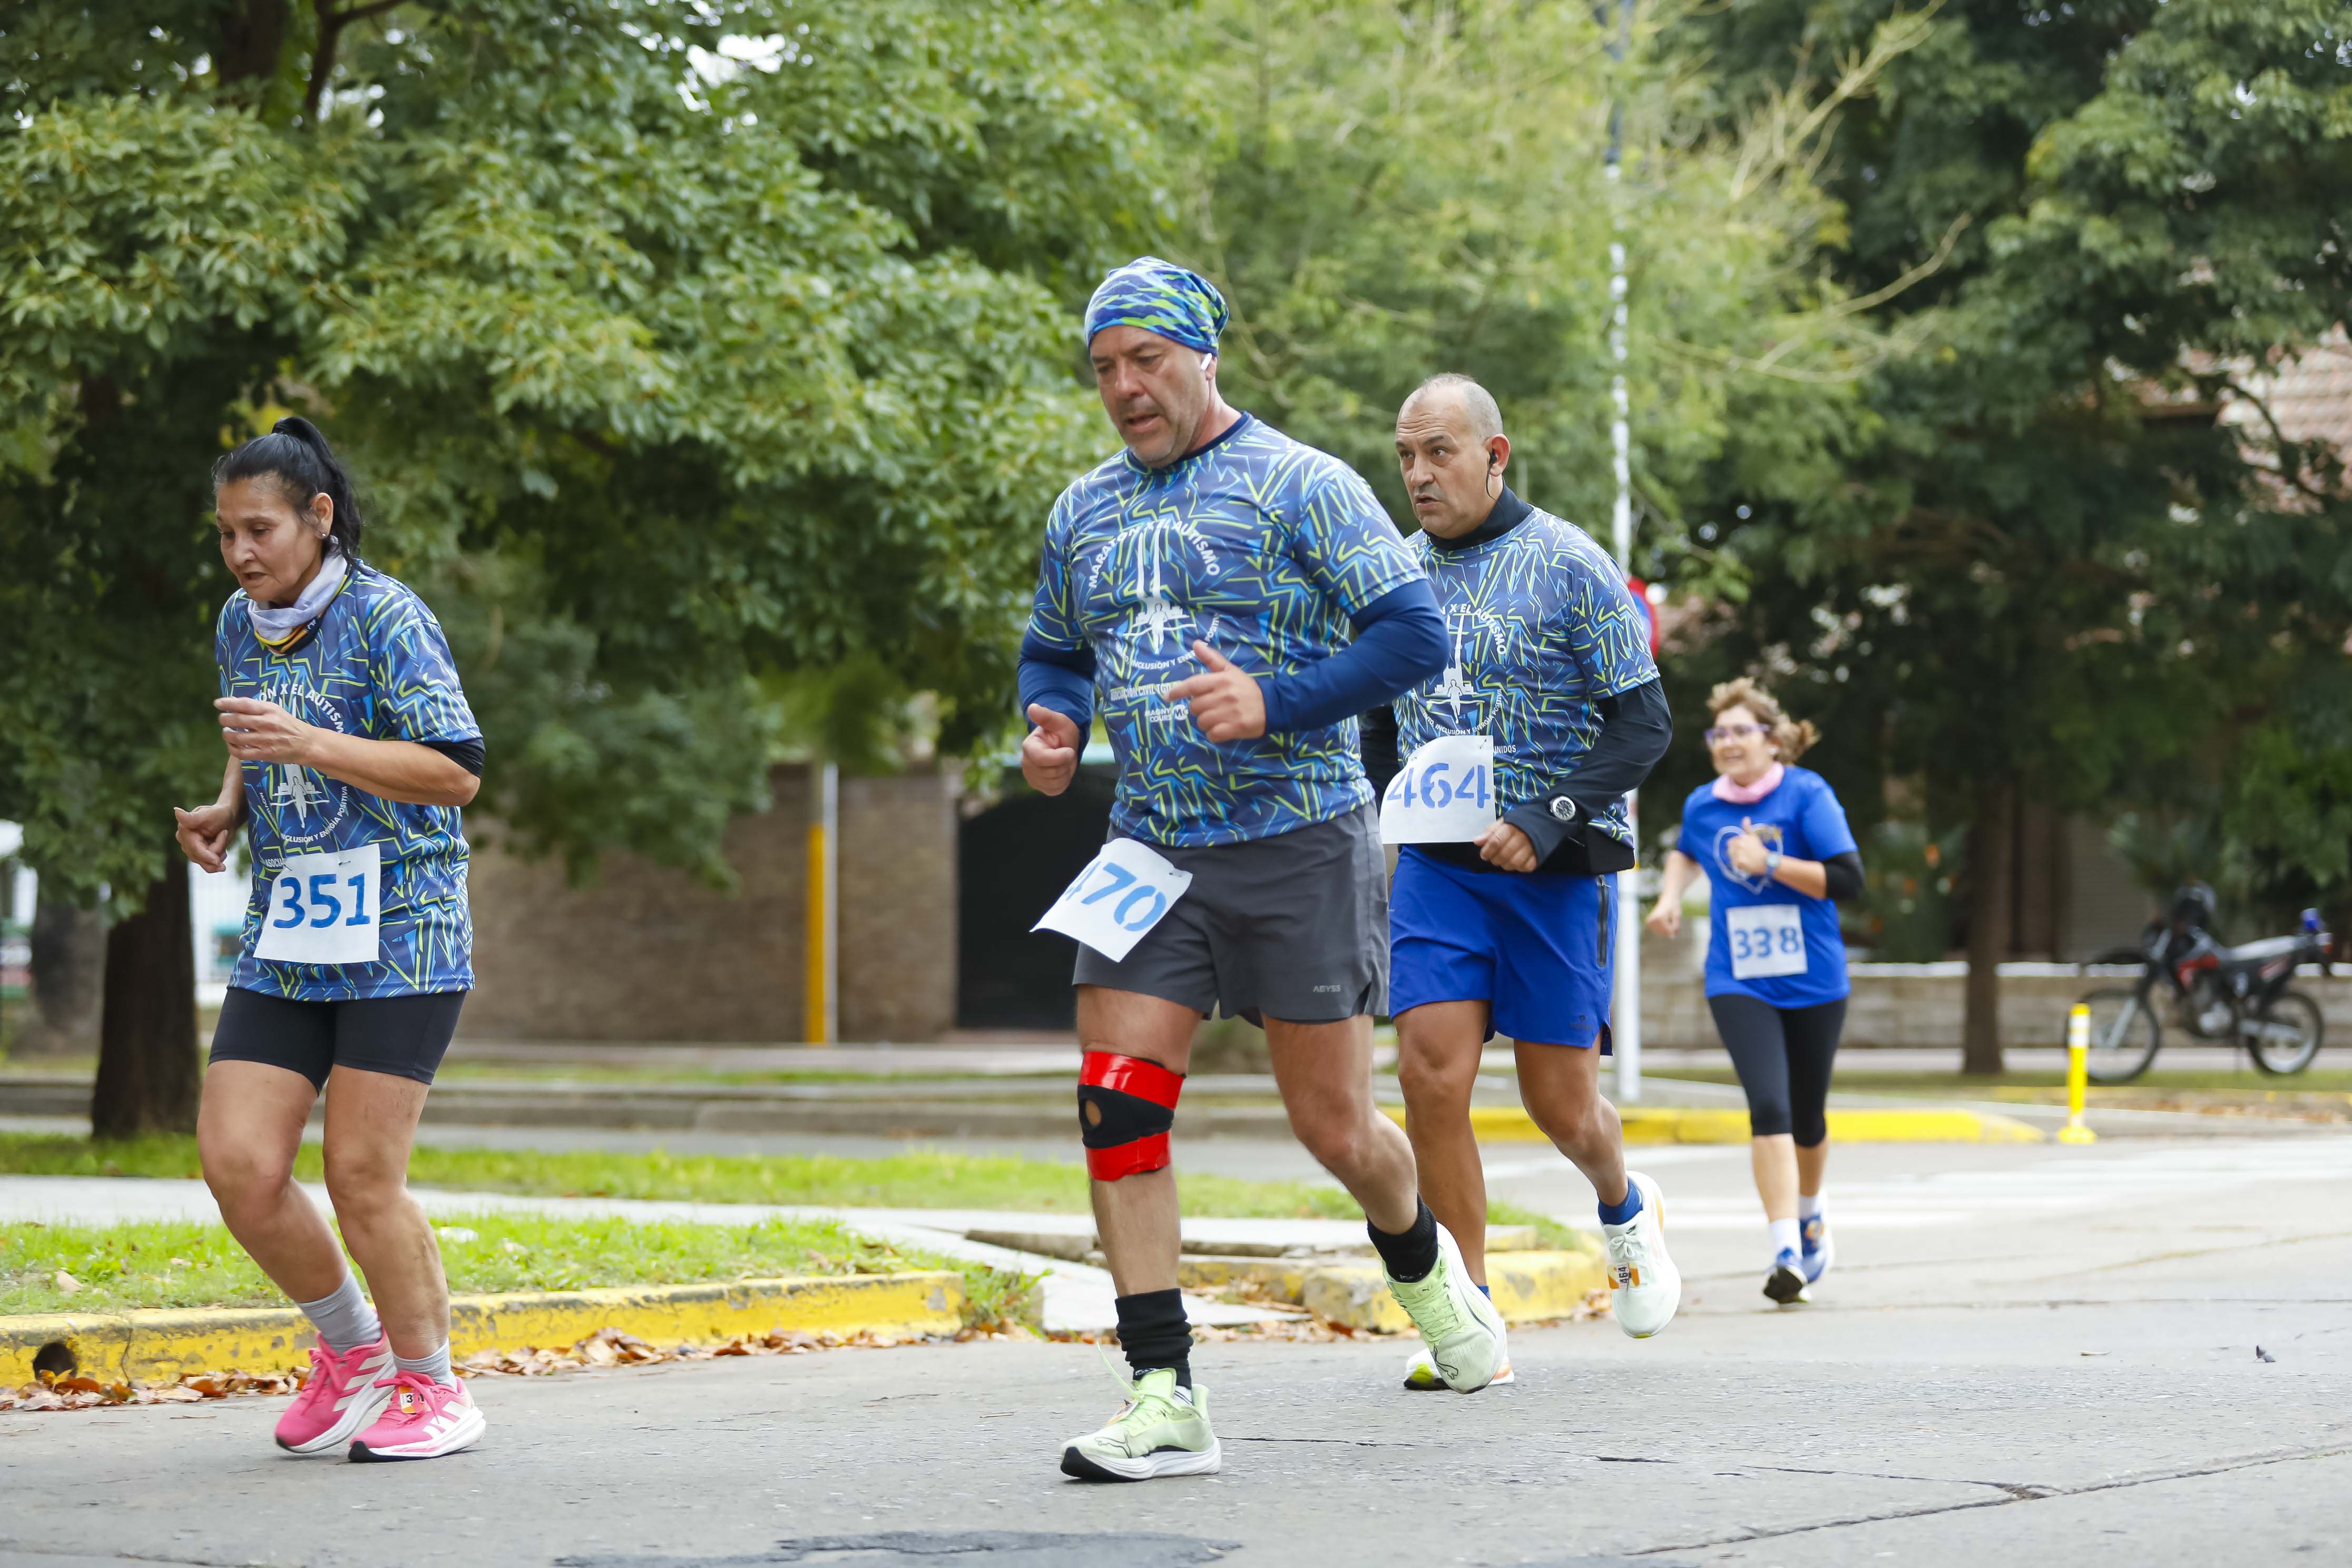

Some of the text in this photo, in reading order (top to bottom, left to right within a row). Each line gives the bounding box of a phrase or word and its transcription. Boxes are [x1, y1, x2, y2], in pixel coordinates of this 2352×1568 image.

[1172, 521, 1220, 575] AUTISMO
[1449, 603, 1458, 613] X
[1461, 603, 1472, 613] EL
[1475, 607, 1507, 655] AUTISMO
[1139, 684, 1156, 695] CIVIL
[1492, 689, 1502, 716] POSITIVA
[280, 683, 289, 694] X
[291, 683, 303, 697] EL
[305, 690, 345, 733] AUTISM
[1145, 708, 1170, 717] MAGNY
[337, 786, 348, 817] POSITIVA
[1387, 763, 1491, 809] 464
[273, 873, 370, 928] 351
[1734, 926, 1799, 960] 338
[1618, 1267, 1629, 1283] 464
